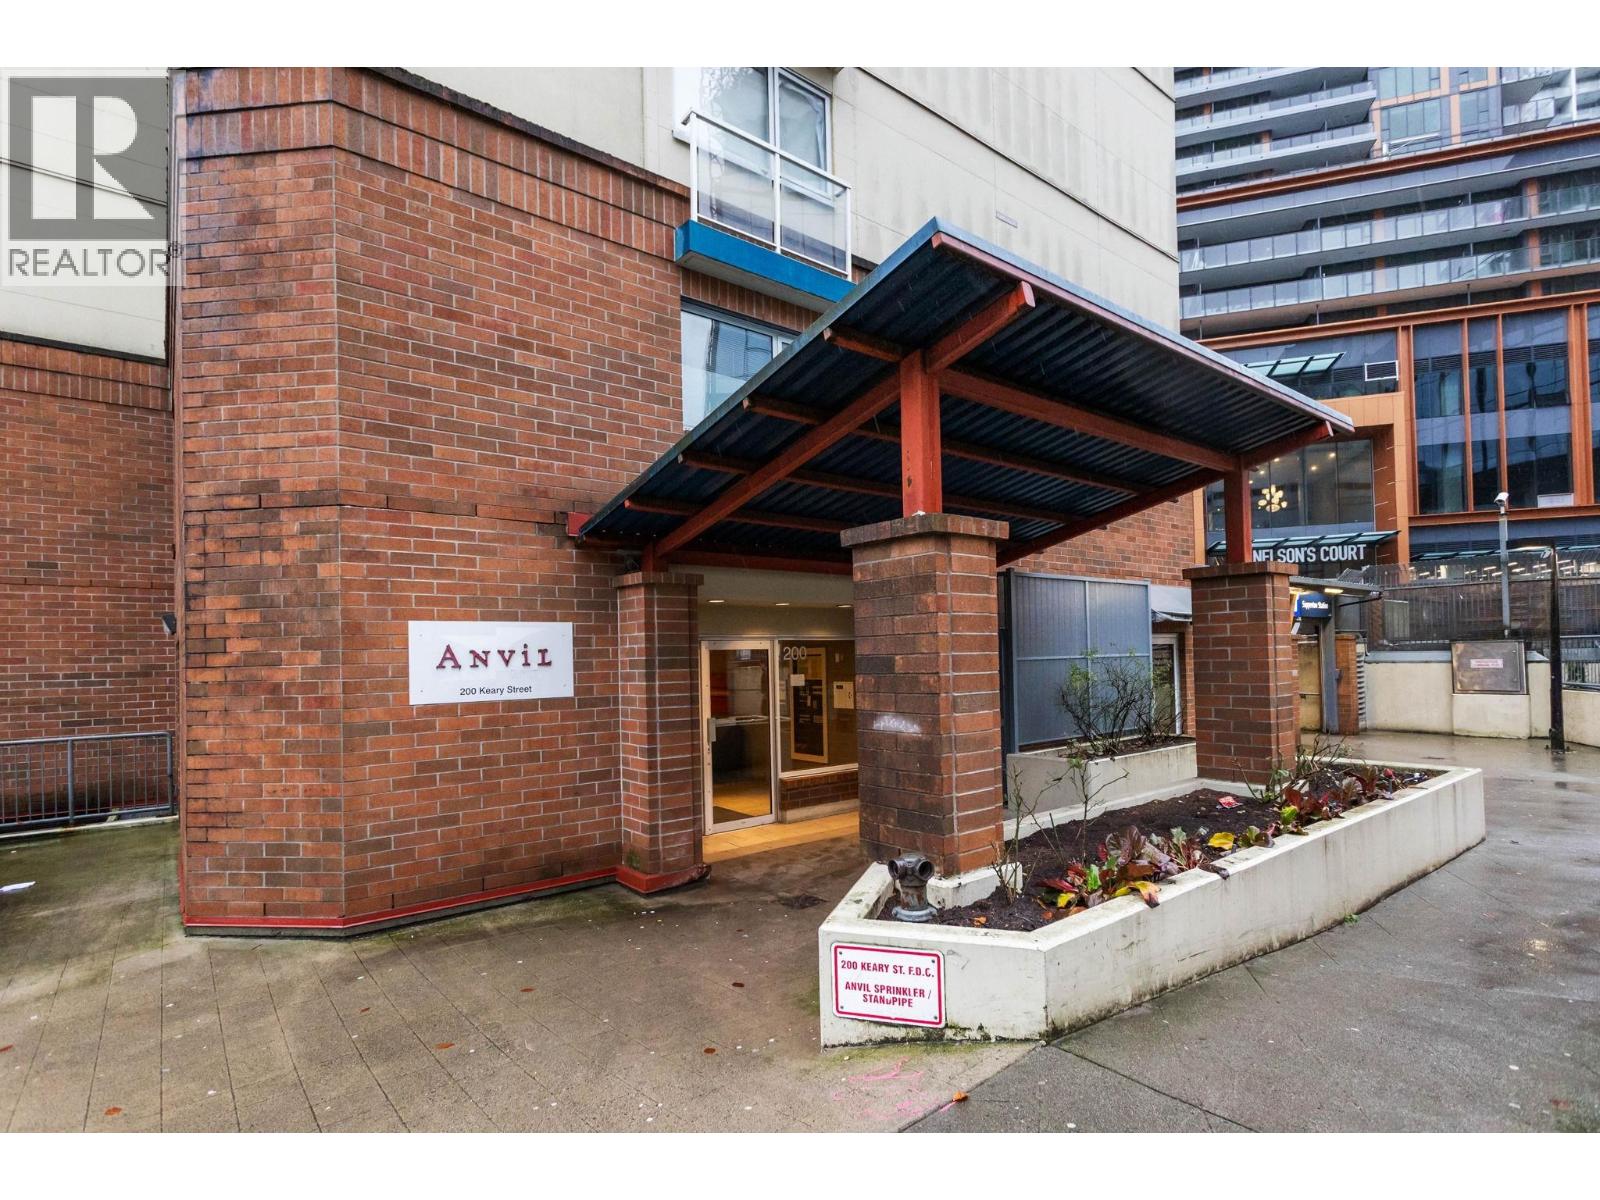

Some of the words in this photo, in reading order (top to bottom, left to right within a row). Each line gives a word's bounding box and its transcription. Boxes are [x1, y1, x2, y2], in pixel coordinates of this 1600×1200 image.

[1320, 544, 1367, 562] COURT
[783, 646, 807, 660] 200
[459, 688, 477, 696] 200
[479, 686, 504, 696] Keary
[506, 685, 532, 694] Street
[841, 960, 858, 970] 200
[860, 962, 890, 973] KEARY
[892, 965, 906, 975] ST.
[845, 981, 871, 993] ANVIL
[874, 984, 925, 998] SPRINKLER
